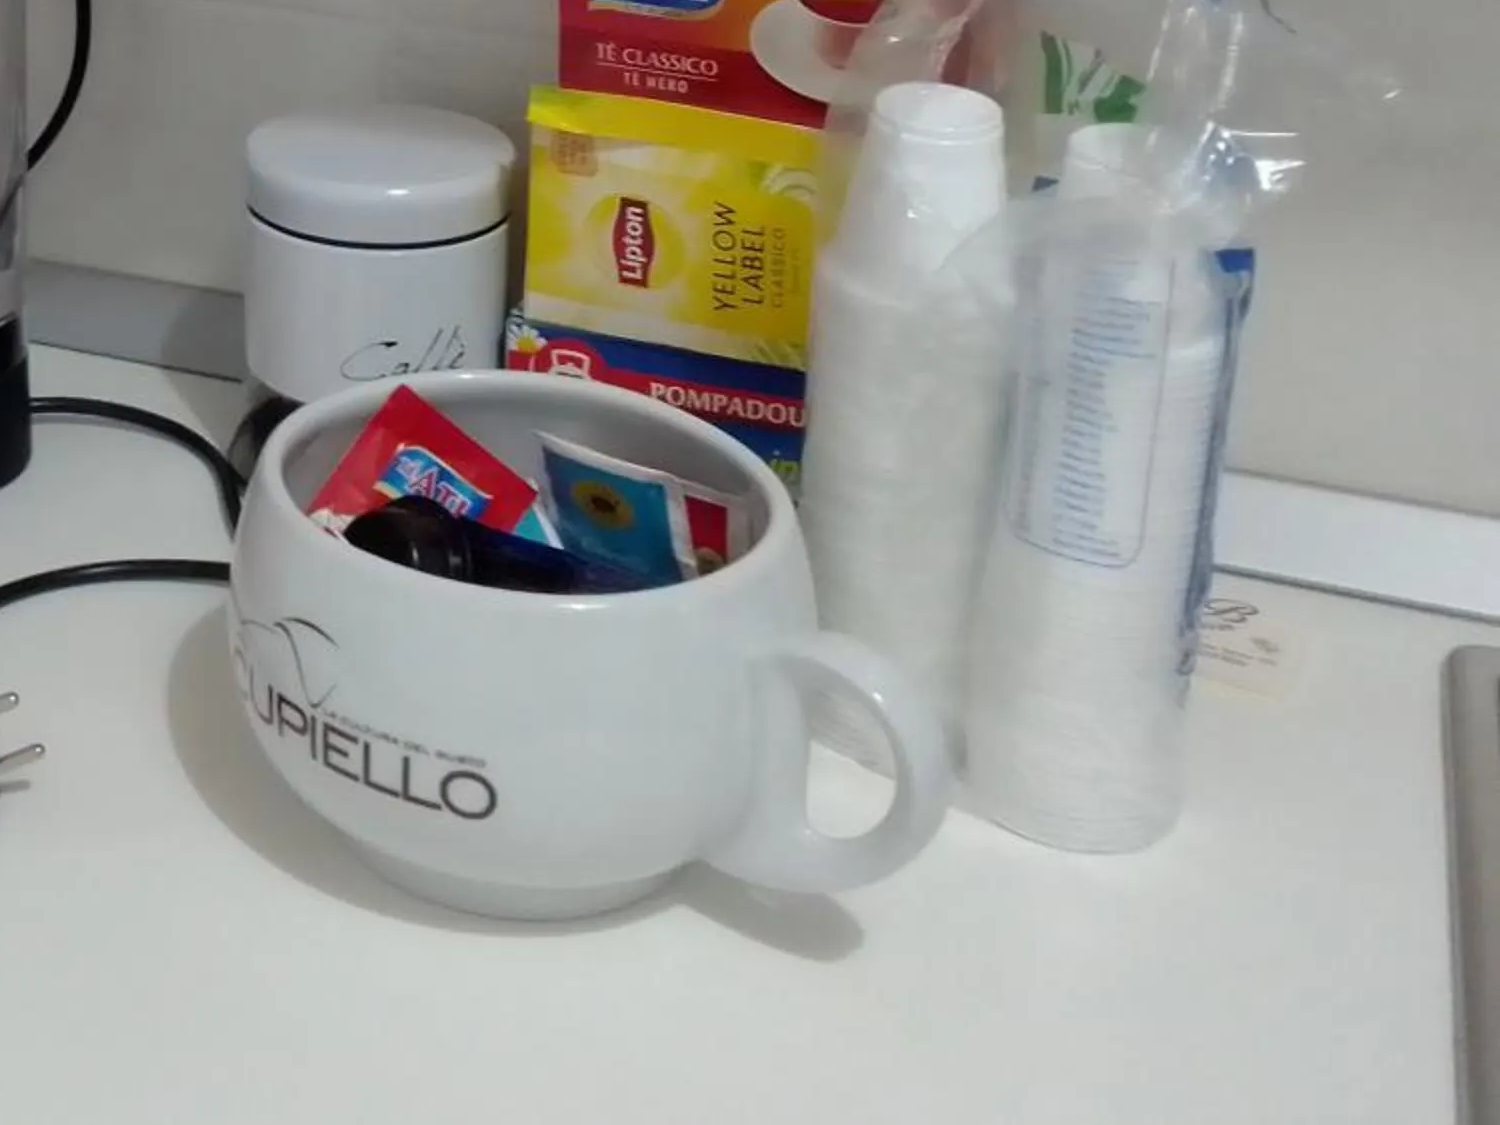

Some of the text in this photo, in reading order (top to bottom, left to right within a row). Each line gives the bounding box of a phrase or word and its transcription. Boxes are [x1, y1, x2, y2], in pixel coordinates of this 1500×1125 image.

[622, 48, 718, 76] CLASSICO
[620, 206, 648, 279] Lipton
[712, 201, 737, 311] YELLOW
[740, 228, 764, 304] LABEL
